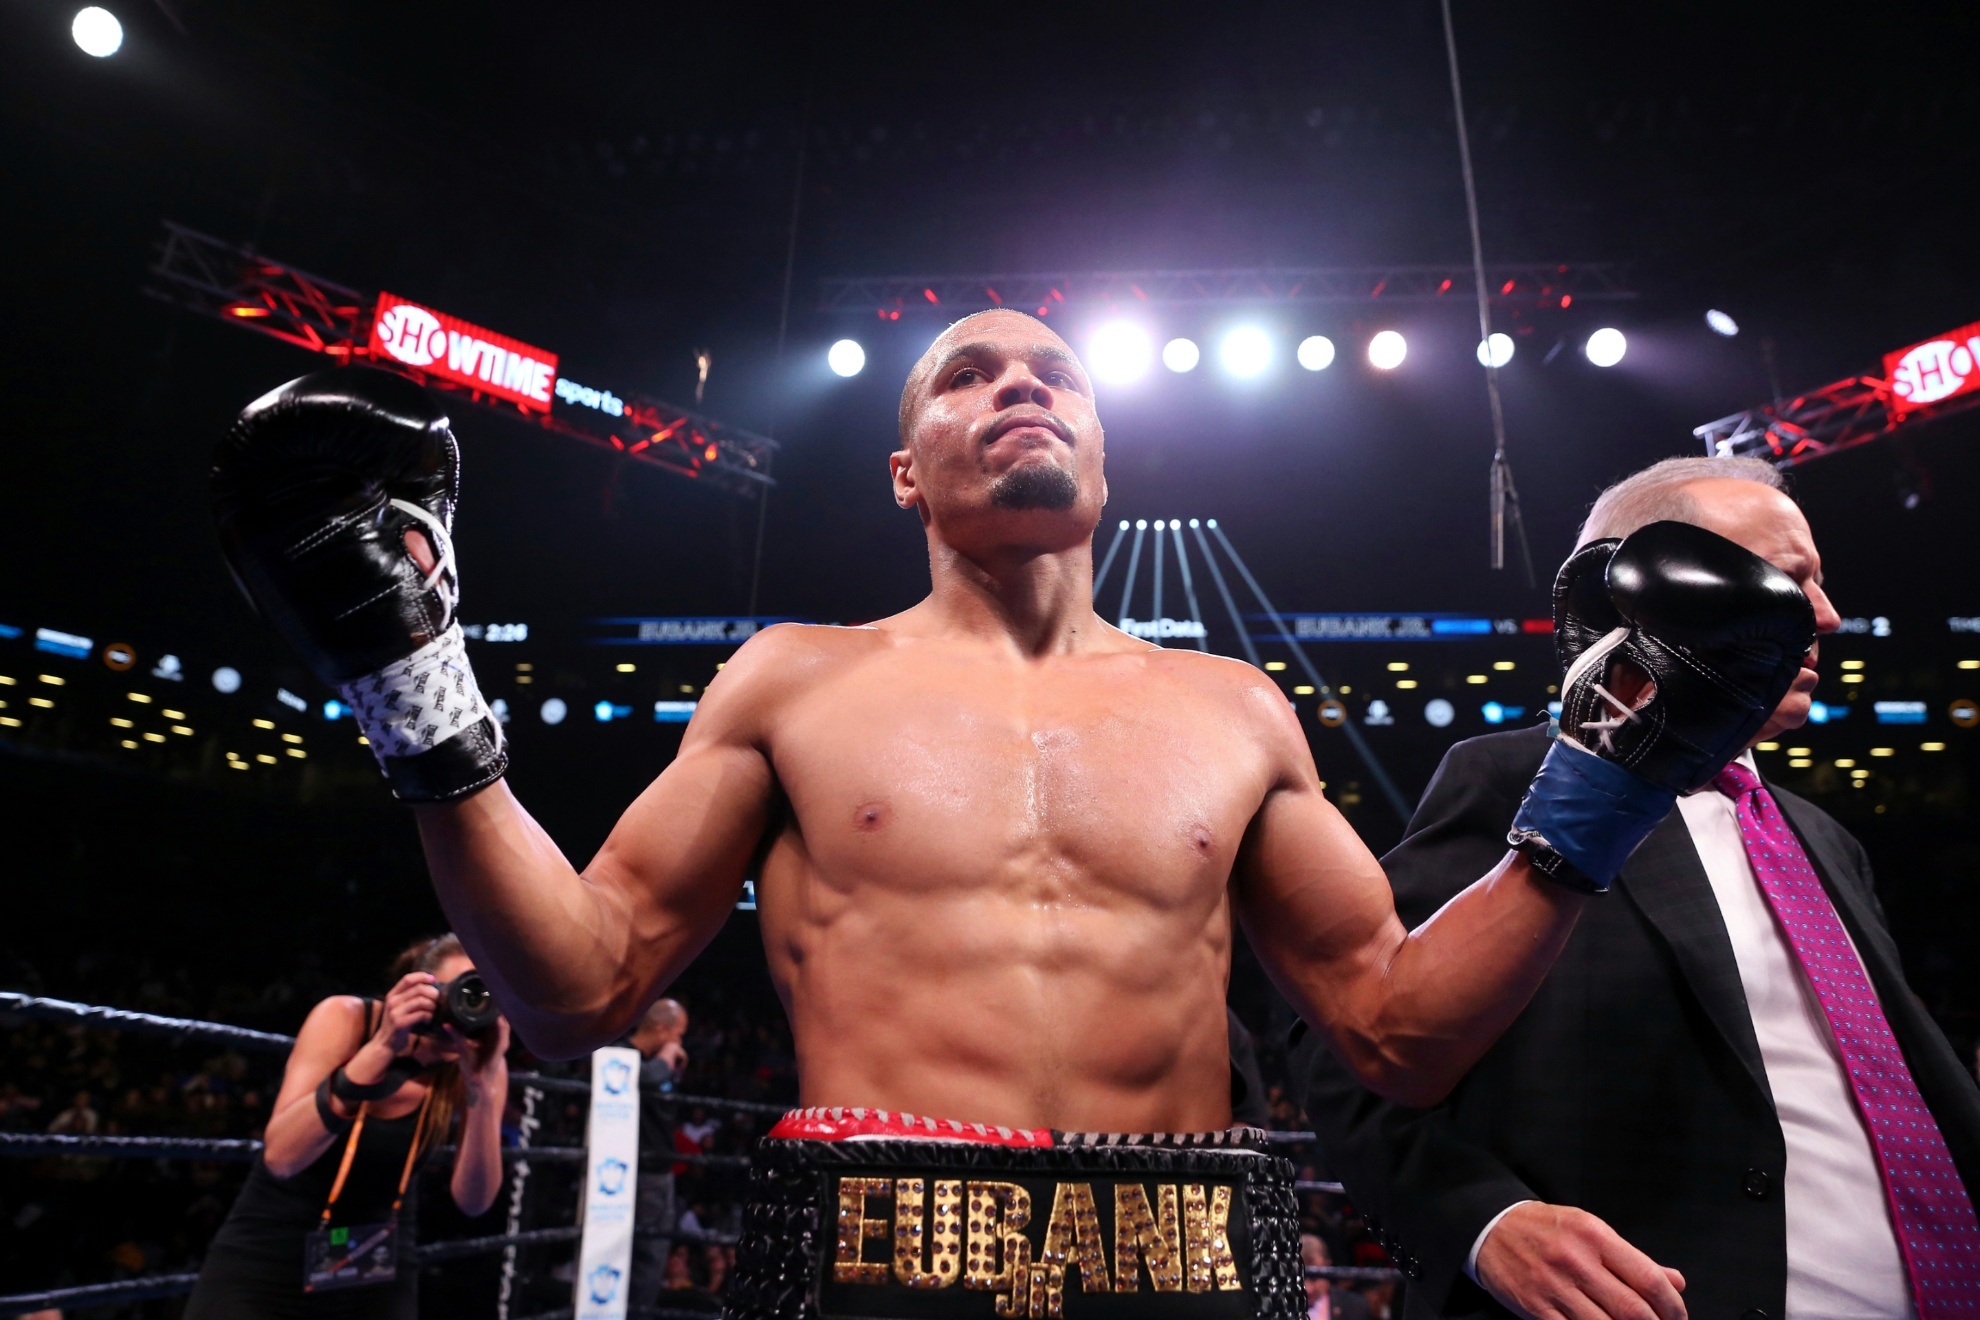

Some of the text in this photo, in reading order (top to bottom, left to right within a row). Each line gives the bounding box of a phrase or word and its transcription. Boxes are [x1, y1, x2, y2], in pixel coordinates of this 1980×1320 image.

[377, 304, 623, 416] SHOWTIME sports
[638, 620, 727, 641] EUBANK
[1295, 617, 1393, 638] EUBANK
[832, 1177, 1243, 1293] EUBANK
